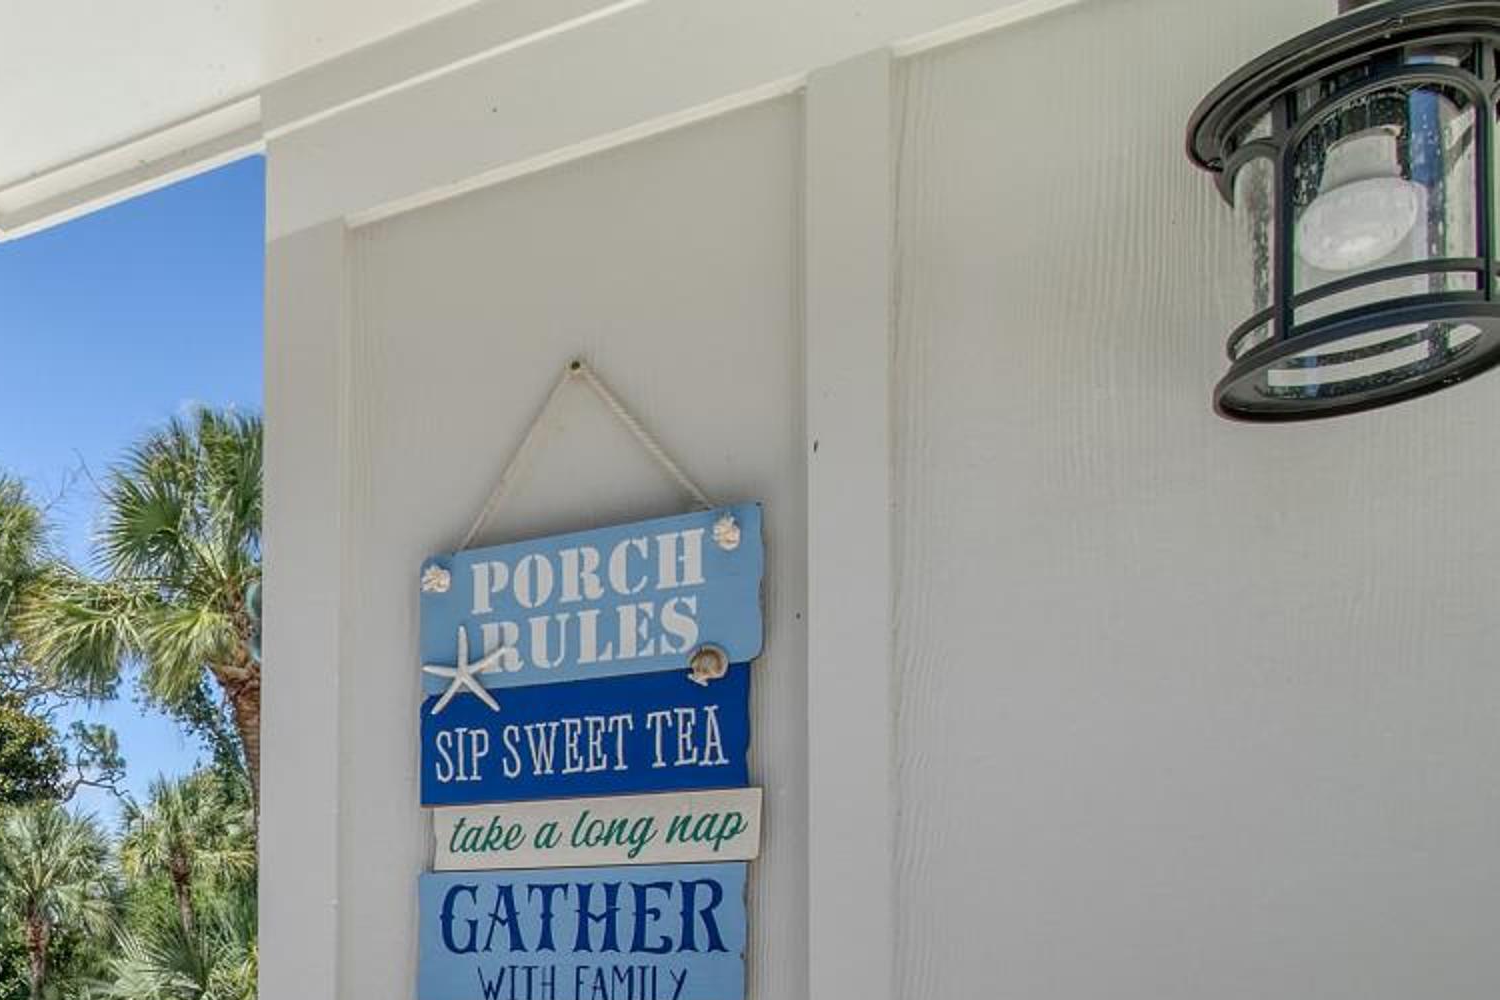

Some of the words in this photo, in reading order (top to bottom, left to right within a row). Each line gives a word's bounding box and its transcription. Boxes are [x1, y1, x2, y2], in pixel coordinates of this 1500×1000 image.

[471, 528, 705, 615] PORCH
[481, 596, 700, 674] RULES
[435, 726, 489, 783] SIP
[502, 713, 633, 778] SWEET
[646, 705, 729, 768] TEA
[449, 815, 525, 853] take
[533, 818, 562, 849] a
[571, 810, 658, 858] long
[665, 811, 748, 851] nap
[440, 878, 729, 954] GATHER
